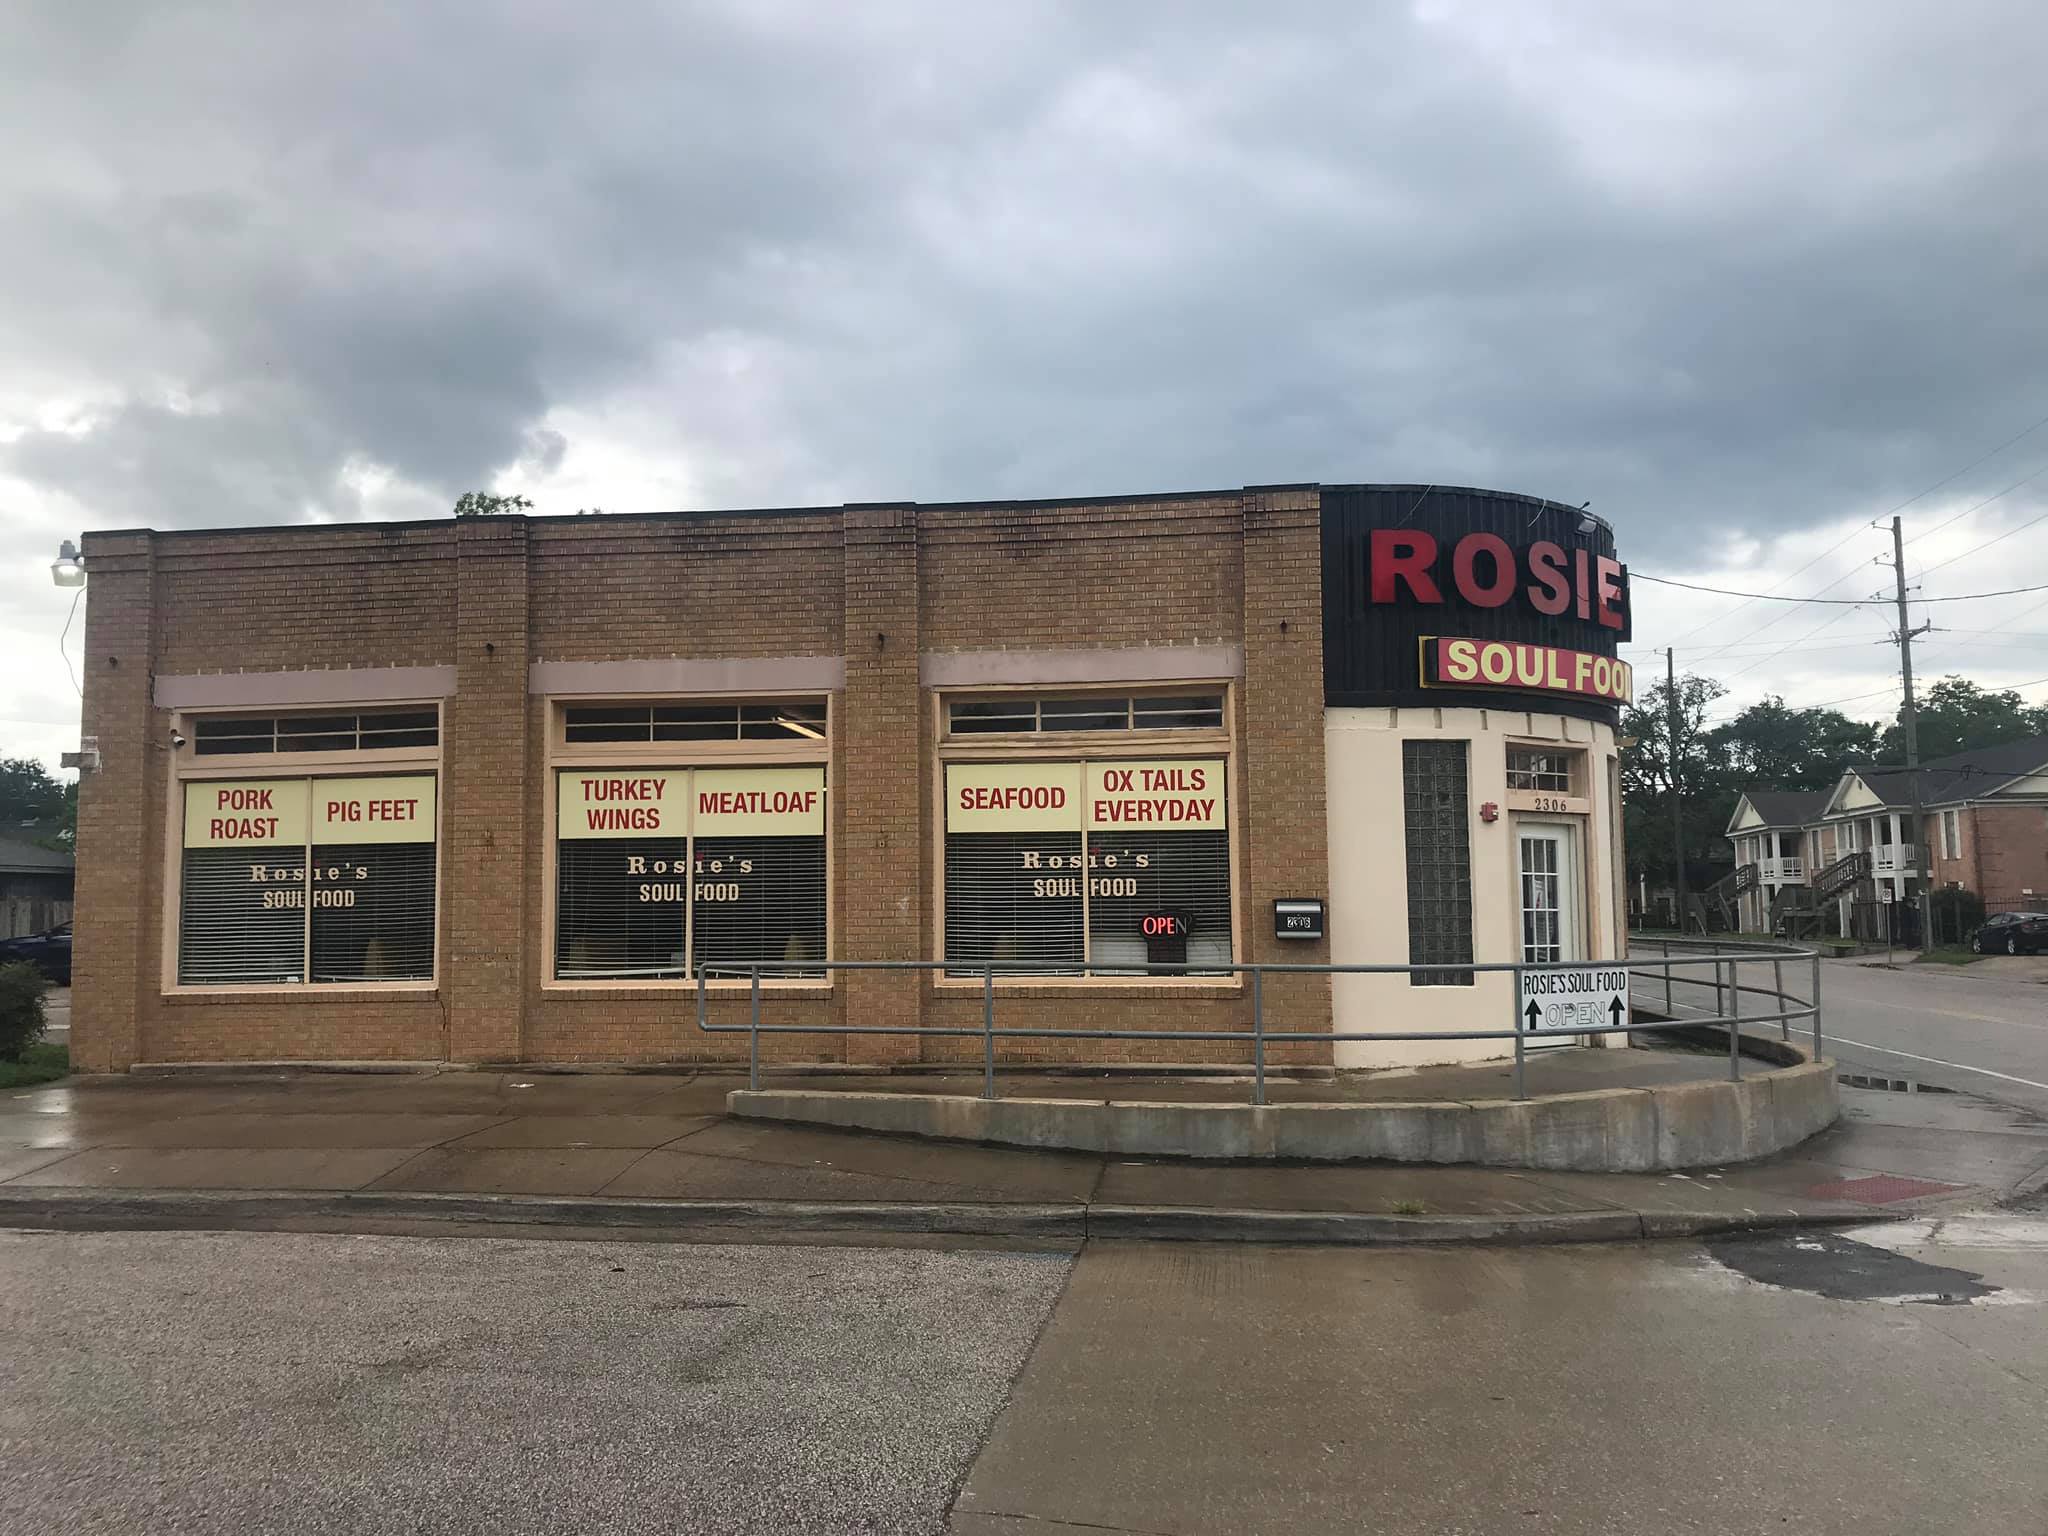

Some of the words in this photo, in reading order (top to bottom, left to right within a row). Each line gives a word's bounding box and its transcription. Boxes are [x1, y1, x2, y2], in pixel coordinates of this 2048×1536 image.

[1371, 529, 1624, 630] ROSIE
[1447, 640, 1568, 689] SOUL
[581, 779, 666, 801] TURKEY
[1103, 770, 1134, 792] OX
[1140, 768, 1206, 791] TAILS
[217, 790, 273, 810] PORK
[699, 791, 817, 814] MEATLOAF
[960, 787, 1066, 809] SEAFOOD
[1535, 797, 1567, 811] 2306
[327, 800, 361, 822] PIG
[368, 799, 418, 821] FEET
[587, 808, 660, 830] WINGS
[1094, 799, 1215, 822] EVERYDAY
[210, 818, 279, 839] ROAST
[627, 853, 753, 875] Rosie's
[1021, 849, 1150, 869] Rosie's
[250, 861, 368, 882] Rosie's
[639, 883, 684, 902] SOUL
[694, 883, 740, 901] FOOD
[1033, 878, 1080, 898] SOUL
[1090, 878, 1137, 897] FOOD
[263, 890, 305, 910] SOUL
[313, 889, 355, 908] FOOD
[1143, 917, 1188, 936] OPEN
[1524, 974, 1566, 995] ROSIE'S
[1567, 973, 1595, 993] SOUL
[1596, 971, 1626, 992] FOOD
[1545, 1001, 1606, 1027] OPEN
